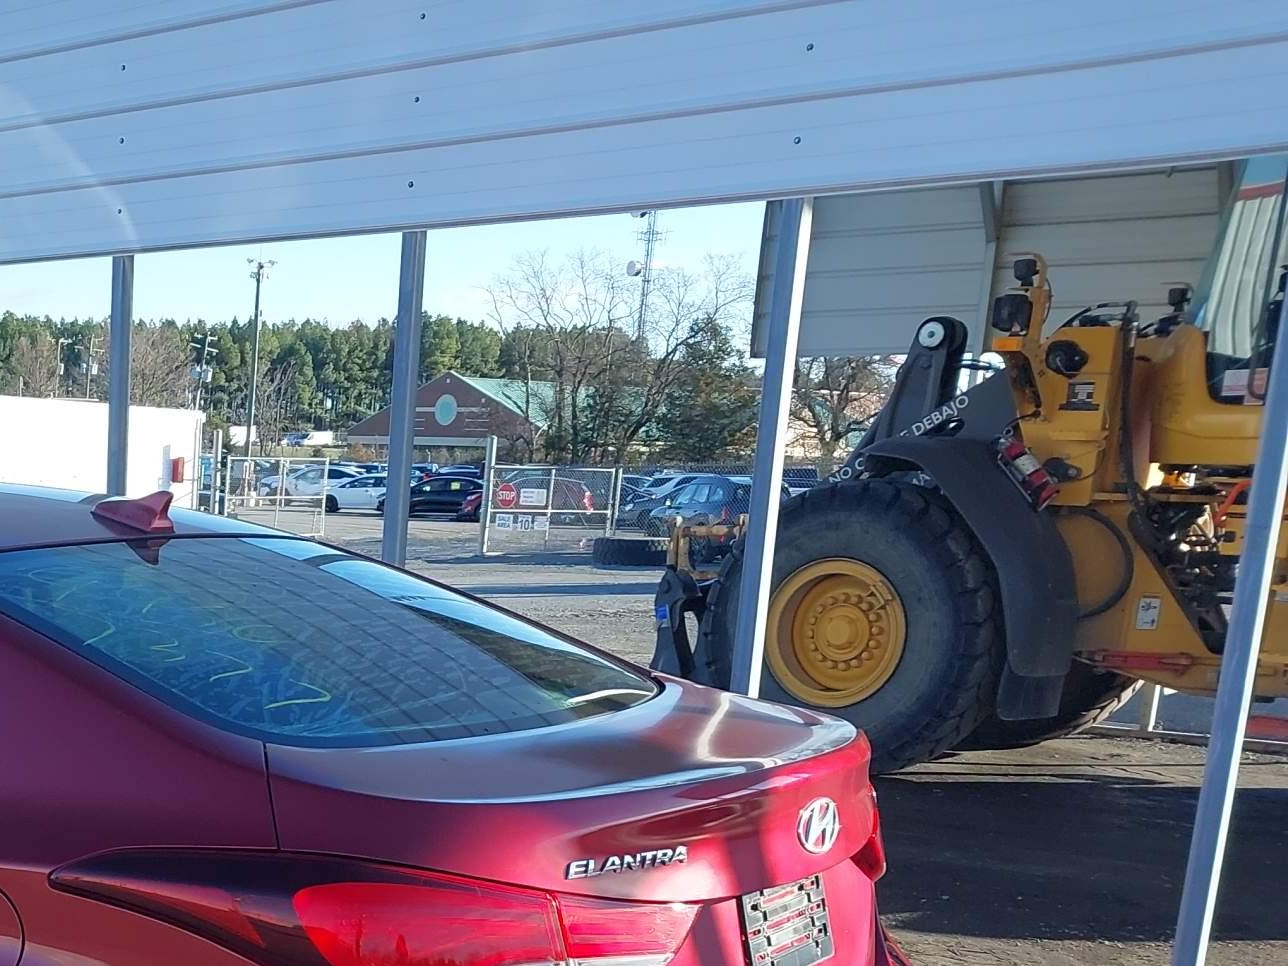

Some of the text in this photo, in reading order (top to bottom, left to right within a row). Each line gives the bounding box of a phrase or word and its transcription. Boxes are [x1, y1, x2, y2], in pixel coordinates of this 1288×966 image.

[829, 395, 969, 483] NO DEBAJO
[498, 491, 515, 500] STOP
[519, 520, 530, 530] 10
[566, 845, 689, 880] ELANTRA
